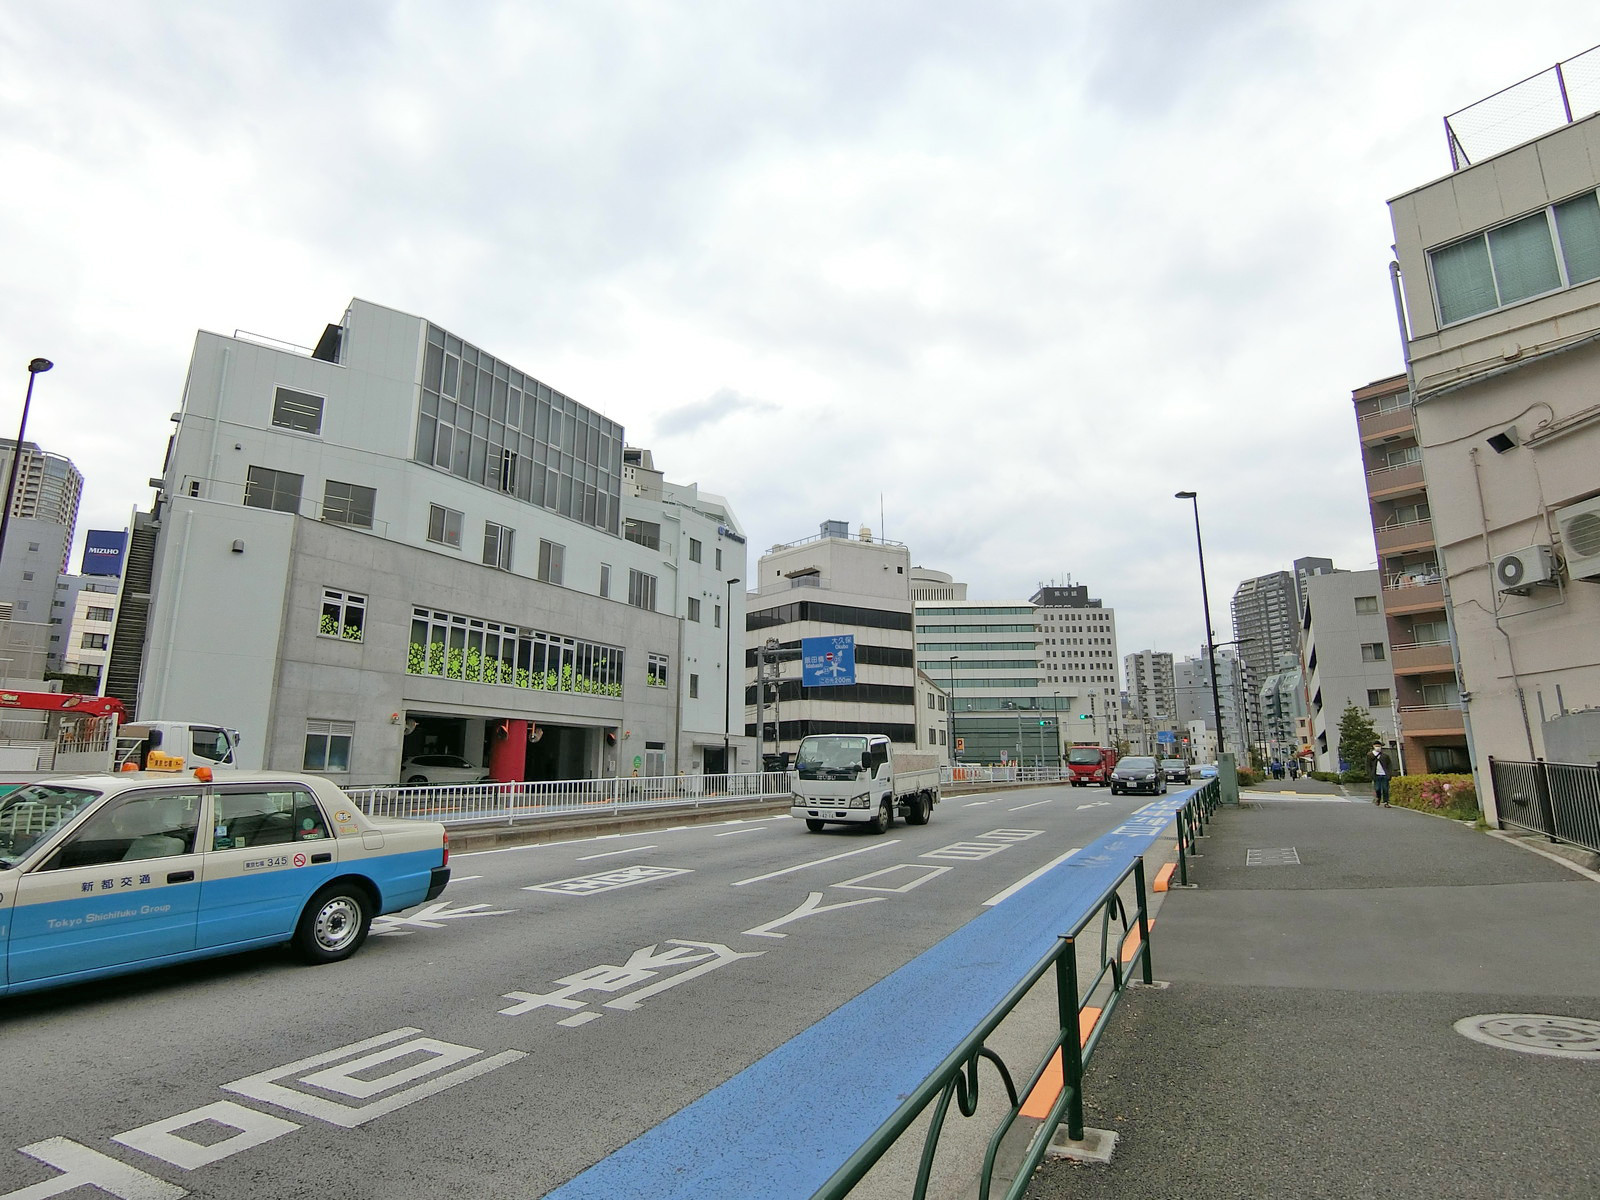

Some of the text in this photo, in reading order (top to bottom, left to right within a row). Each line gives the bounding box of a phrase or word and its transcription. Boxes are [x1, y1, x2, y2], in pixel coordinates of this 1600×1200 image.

[88, 547, 119, 555] MIZUHO
[832, 636, 852, 644] 大久保
[267, 857, 287, 867] 345
[81, 874, 152, 893] 新都交通
[47, 903, 171, 929] Tokyo Shichifuku Group
